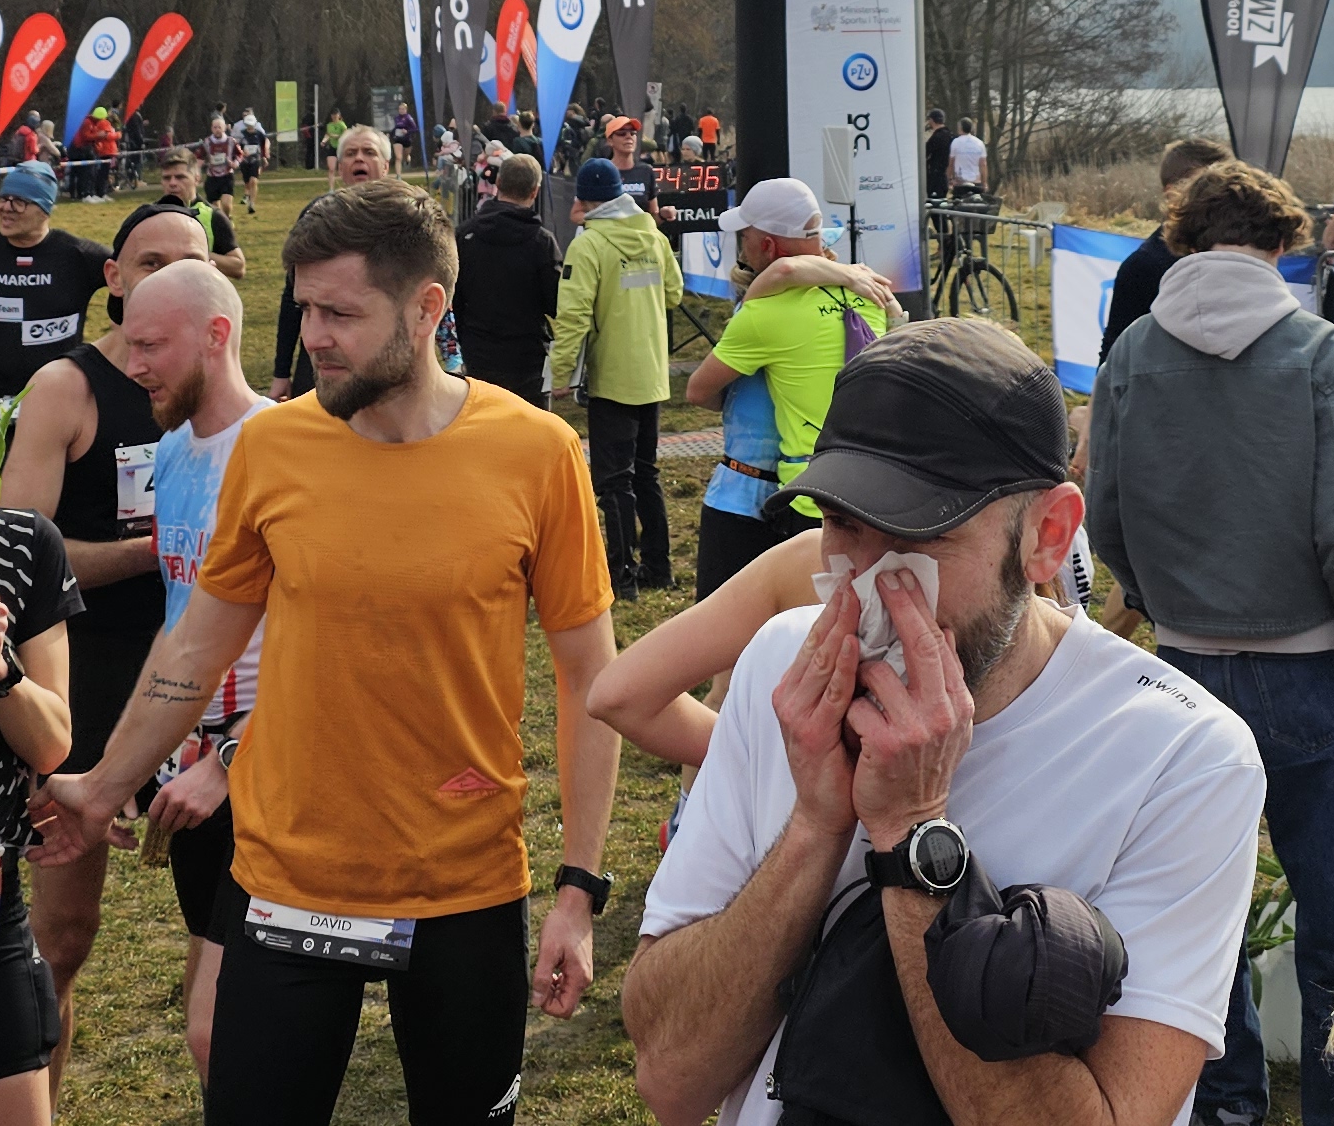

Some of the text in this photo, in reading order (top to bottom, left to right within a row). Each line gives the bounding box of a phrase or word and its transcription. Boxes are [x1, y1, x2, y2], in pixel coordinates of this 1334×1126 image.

[850, 63, 872, 81] PZU
[858, 175, 884, 184] SKLEP
[309, 915, 352, 932] DAVID
